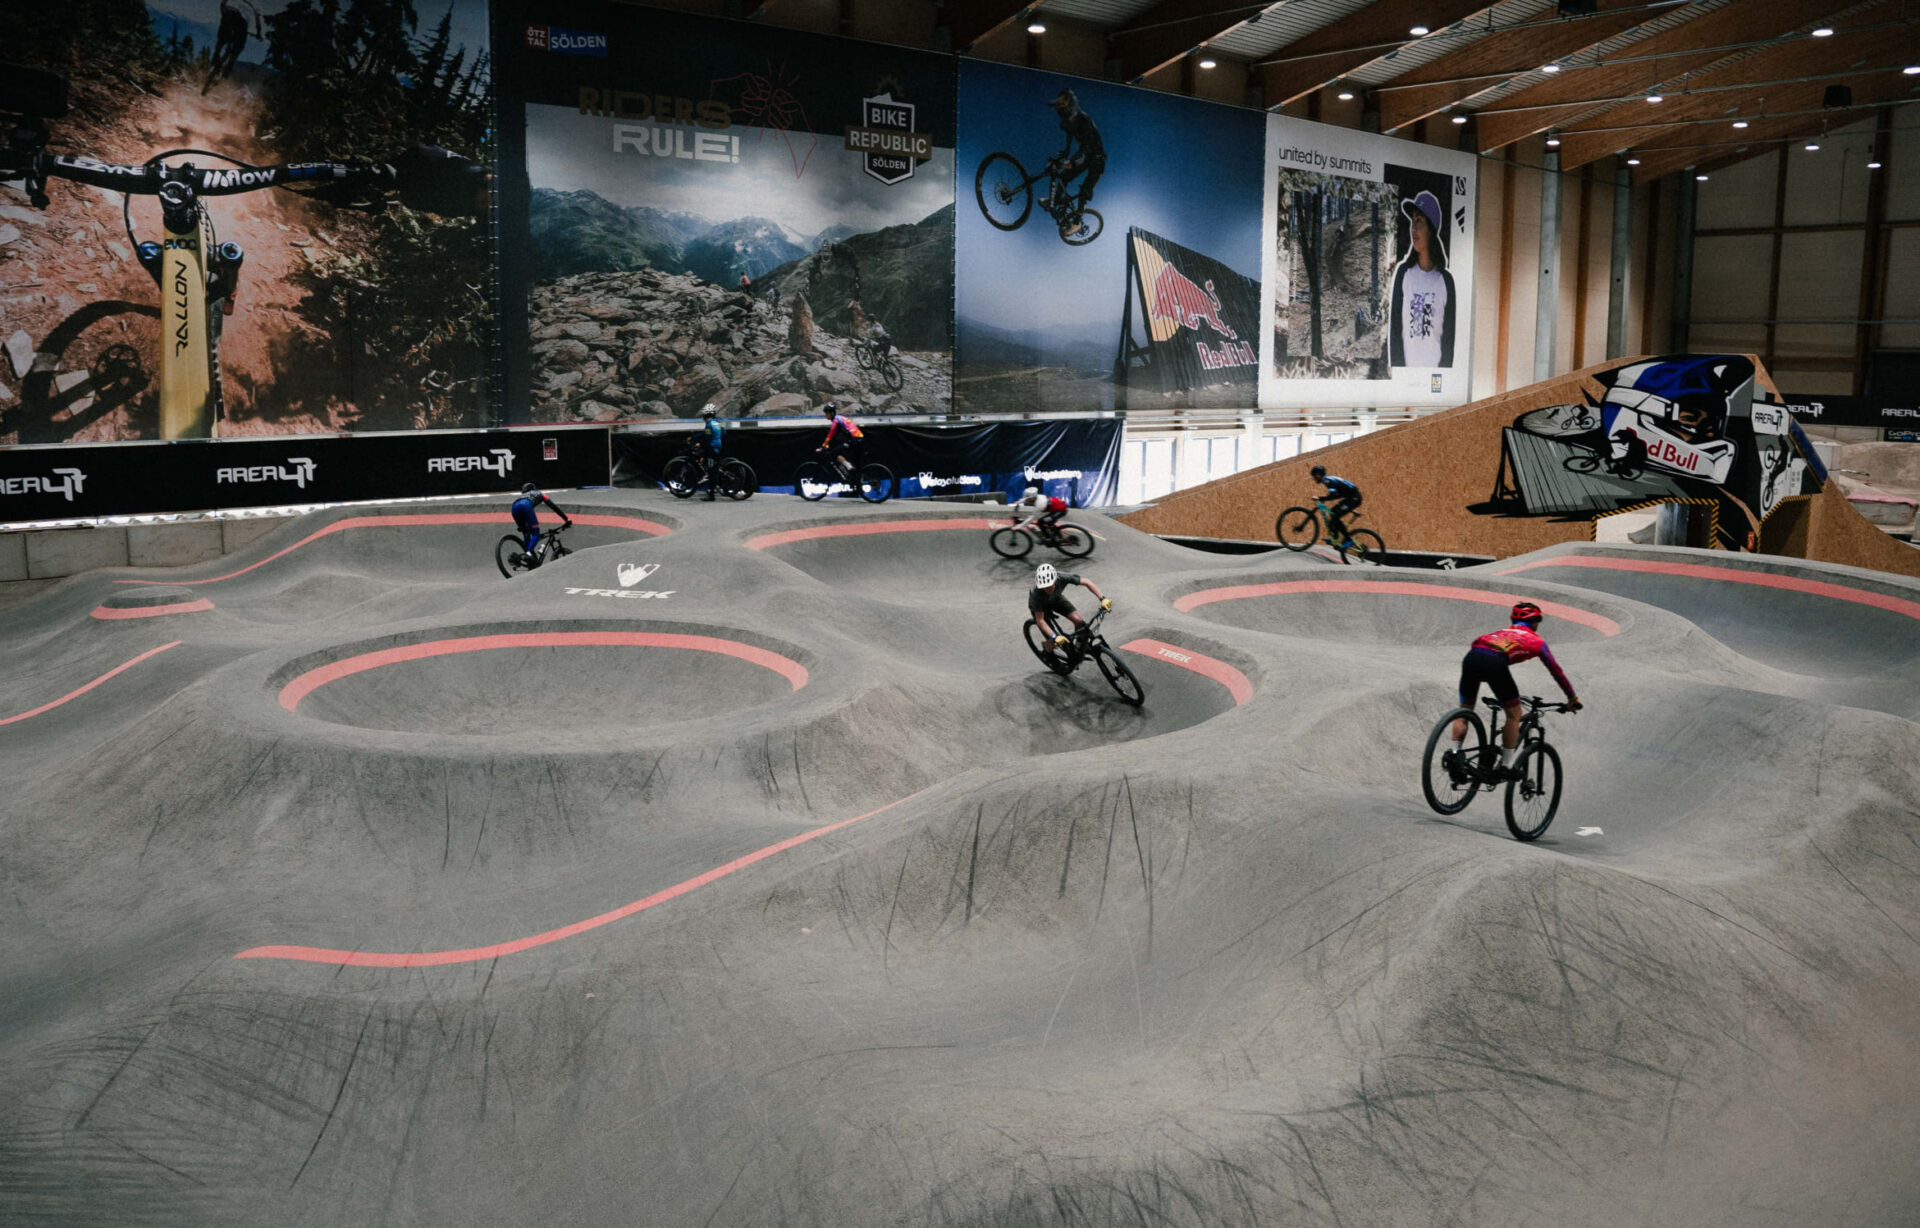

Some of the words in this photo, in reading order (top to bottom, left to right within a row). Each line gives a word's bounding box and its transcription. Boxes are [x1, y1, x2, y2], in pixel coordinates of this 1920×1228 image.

[527, 26, 545, 38] ÖTZ
[527, 37, 545, 47] TAL
[551, 33, 606, 49] SÖLDEN
[579, 86, 731, 130] RIDERS
[871, 108, 907, 127] BIKE
[613, 124, 740, 164] RULE!
[850, 130, 927, 154] REPUBLIC
[57, 155, 144, 176] LEZYNE
[872, 156, 906, 170] SÖLDEN
[1278, 146, 1312, 164] united
[1314, 151, 1327, 170] by
[1329, 156, 1372, 175] summits
[175, 260, 188, 358] RALLON
[428, 448, 516, 478] AREA47
[1662, 443, 1699, 471] Bull
[0, 467, 87, 502] EA47
[217, 457, 317, 489] AREA47
[564, 587, 677, 599] TREK
[1158, 647, 1193, 663] TREK
